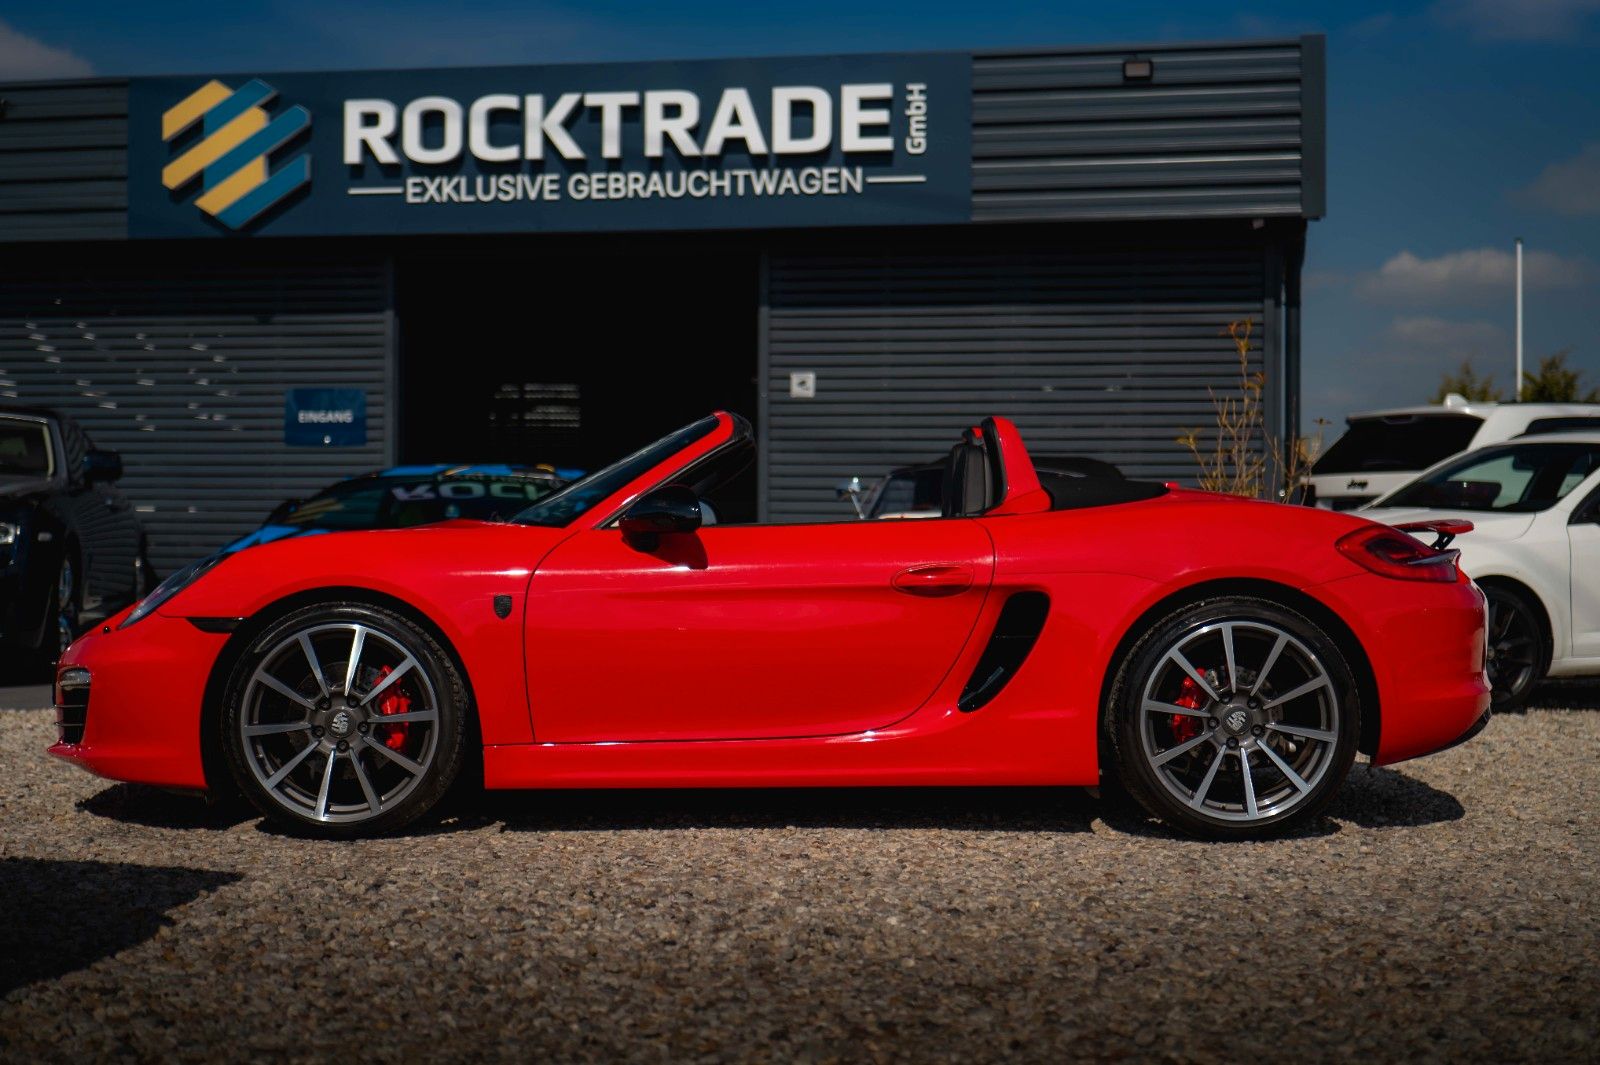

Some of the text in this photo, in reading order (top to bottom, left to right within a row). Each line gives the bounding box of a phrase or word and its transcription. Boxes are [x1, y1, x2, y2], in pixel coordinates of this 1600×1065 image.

[342, 83, 895, 165] ROCKTRADE
[905, 82, 927, 155] GmbH
[405, 166, 863, 204] EXKLUSIVE GEBRAUCHTWAGEN
[298, 409, 354, 424] EINGANG
